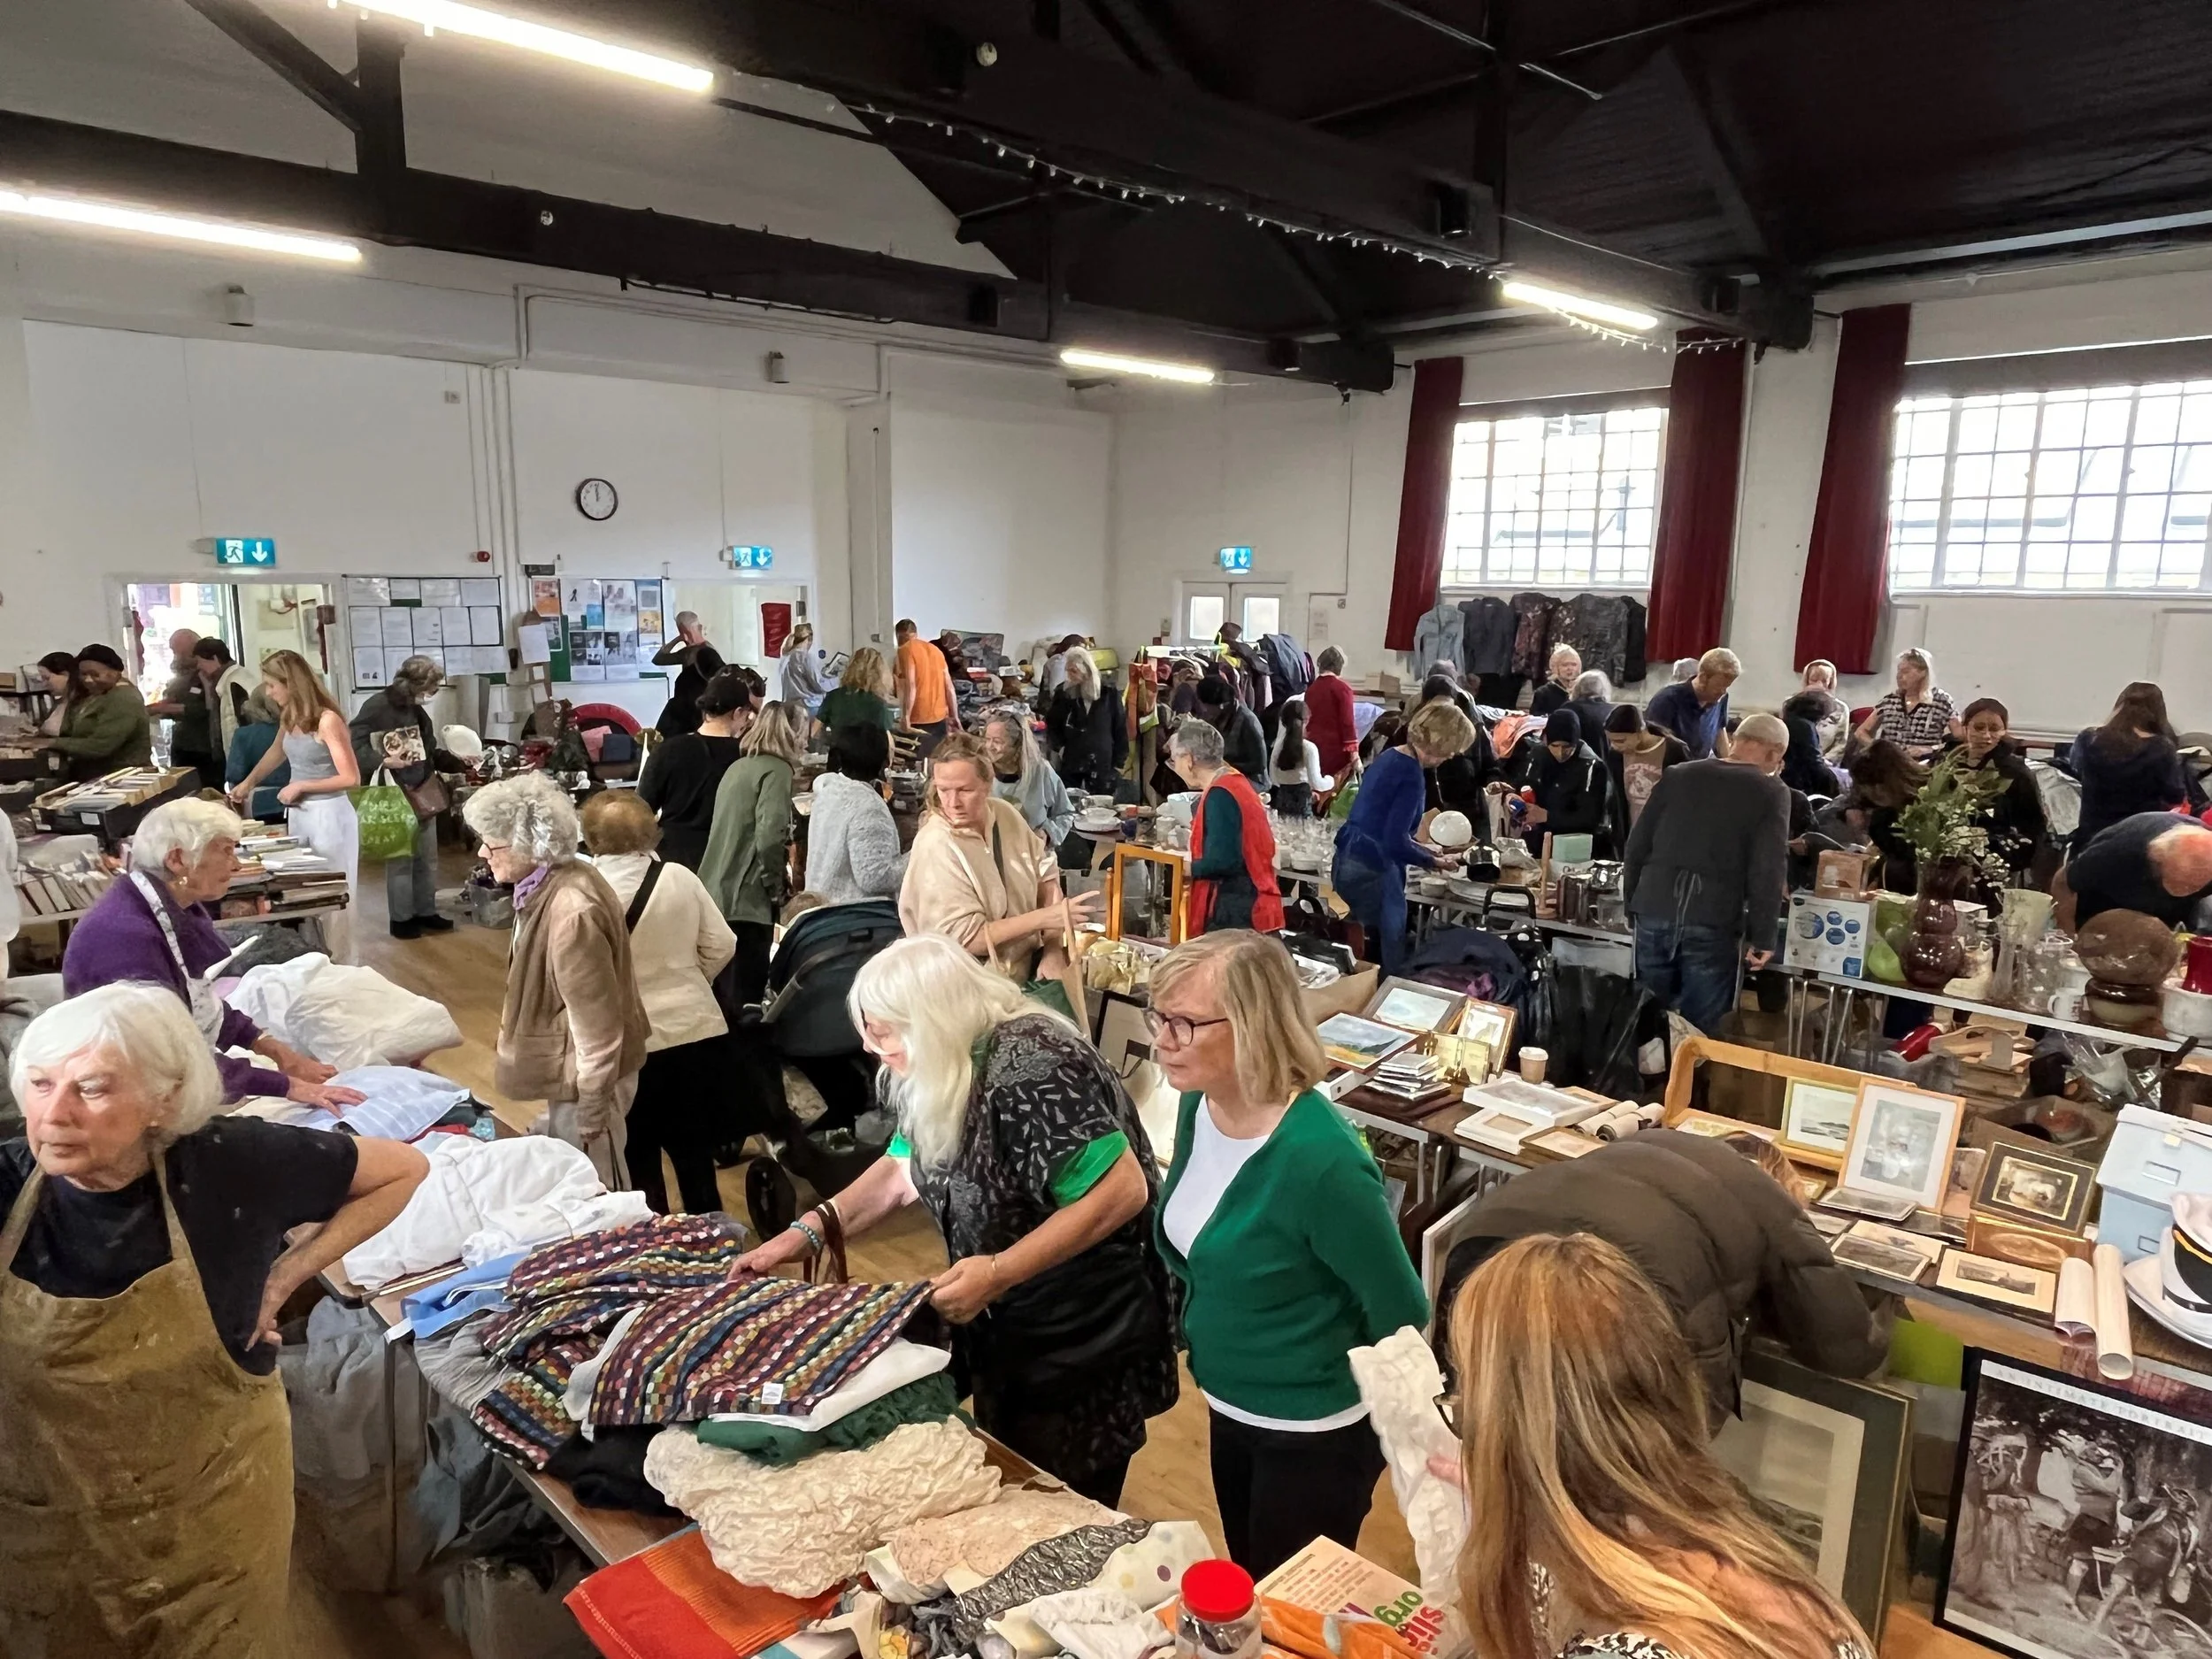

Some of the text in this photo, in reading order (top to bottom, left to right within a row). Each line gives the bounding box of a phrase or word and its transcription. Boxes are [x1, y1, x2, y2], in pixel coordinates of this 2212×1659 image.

[1996, 1369, 2204, 1440] AN INTIMATE PORTRAIT
